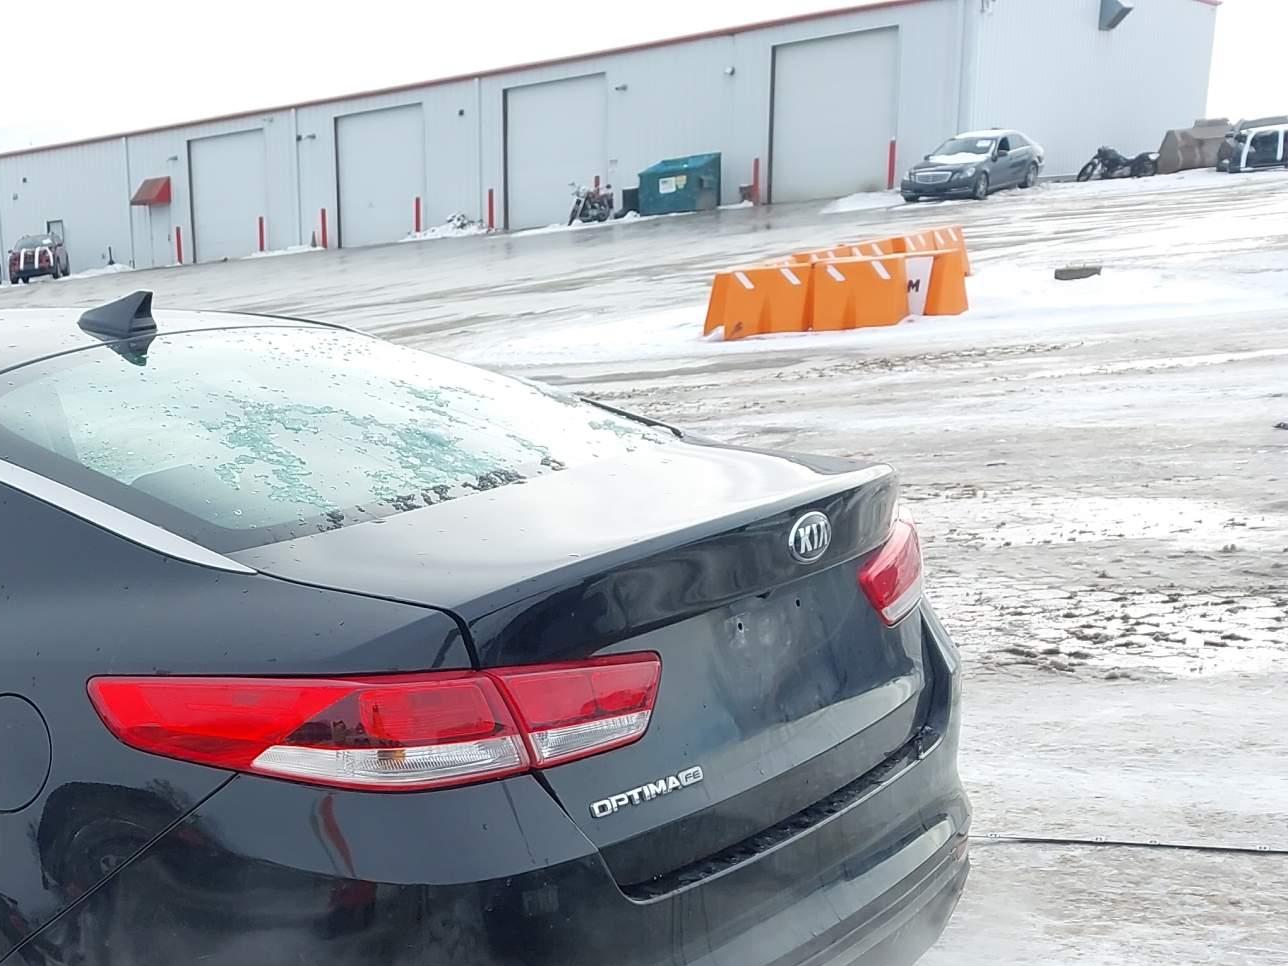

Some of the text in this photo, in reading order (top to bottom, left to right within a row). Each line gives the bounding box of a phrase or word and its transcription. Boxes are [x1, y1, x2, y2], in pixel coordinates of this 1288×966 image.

[907, 279, 921, 293] M
[798, 520, 828, 554] KIA
[590, 775, 682, 818] OPTIMA
